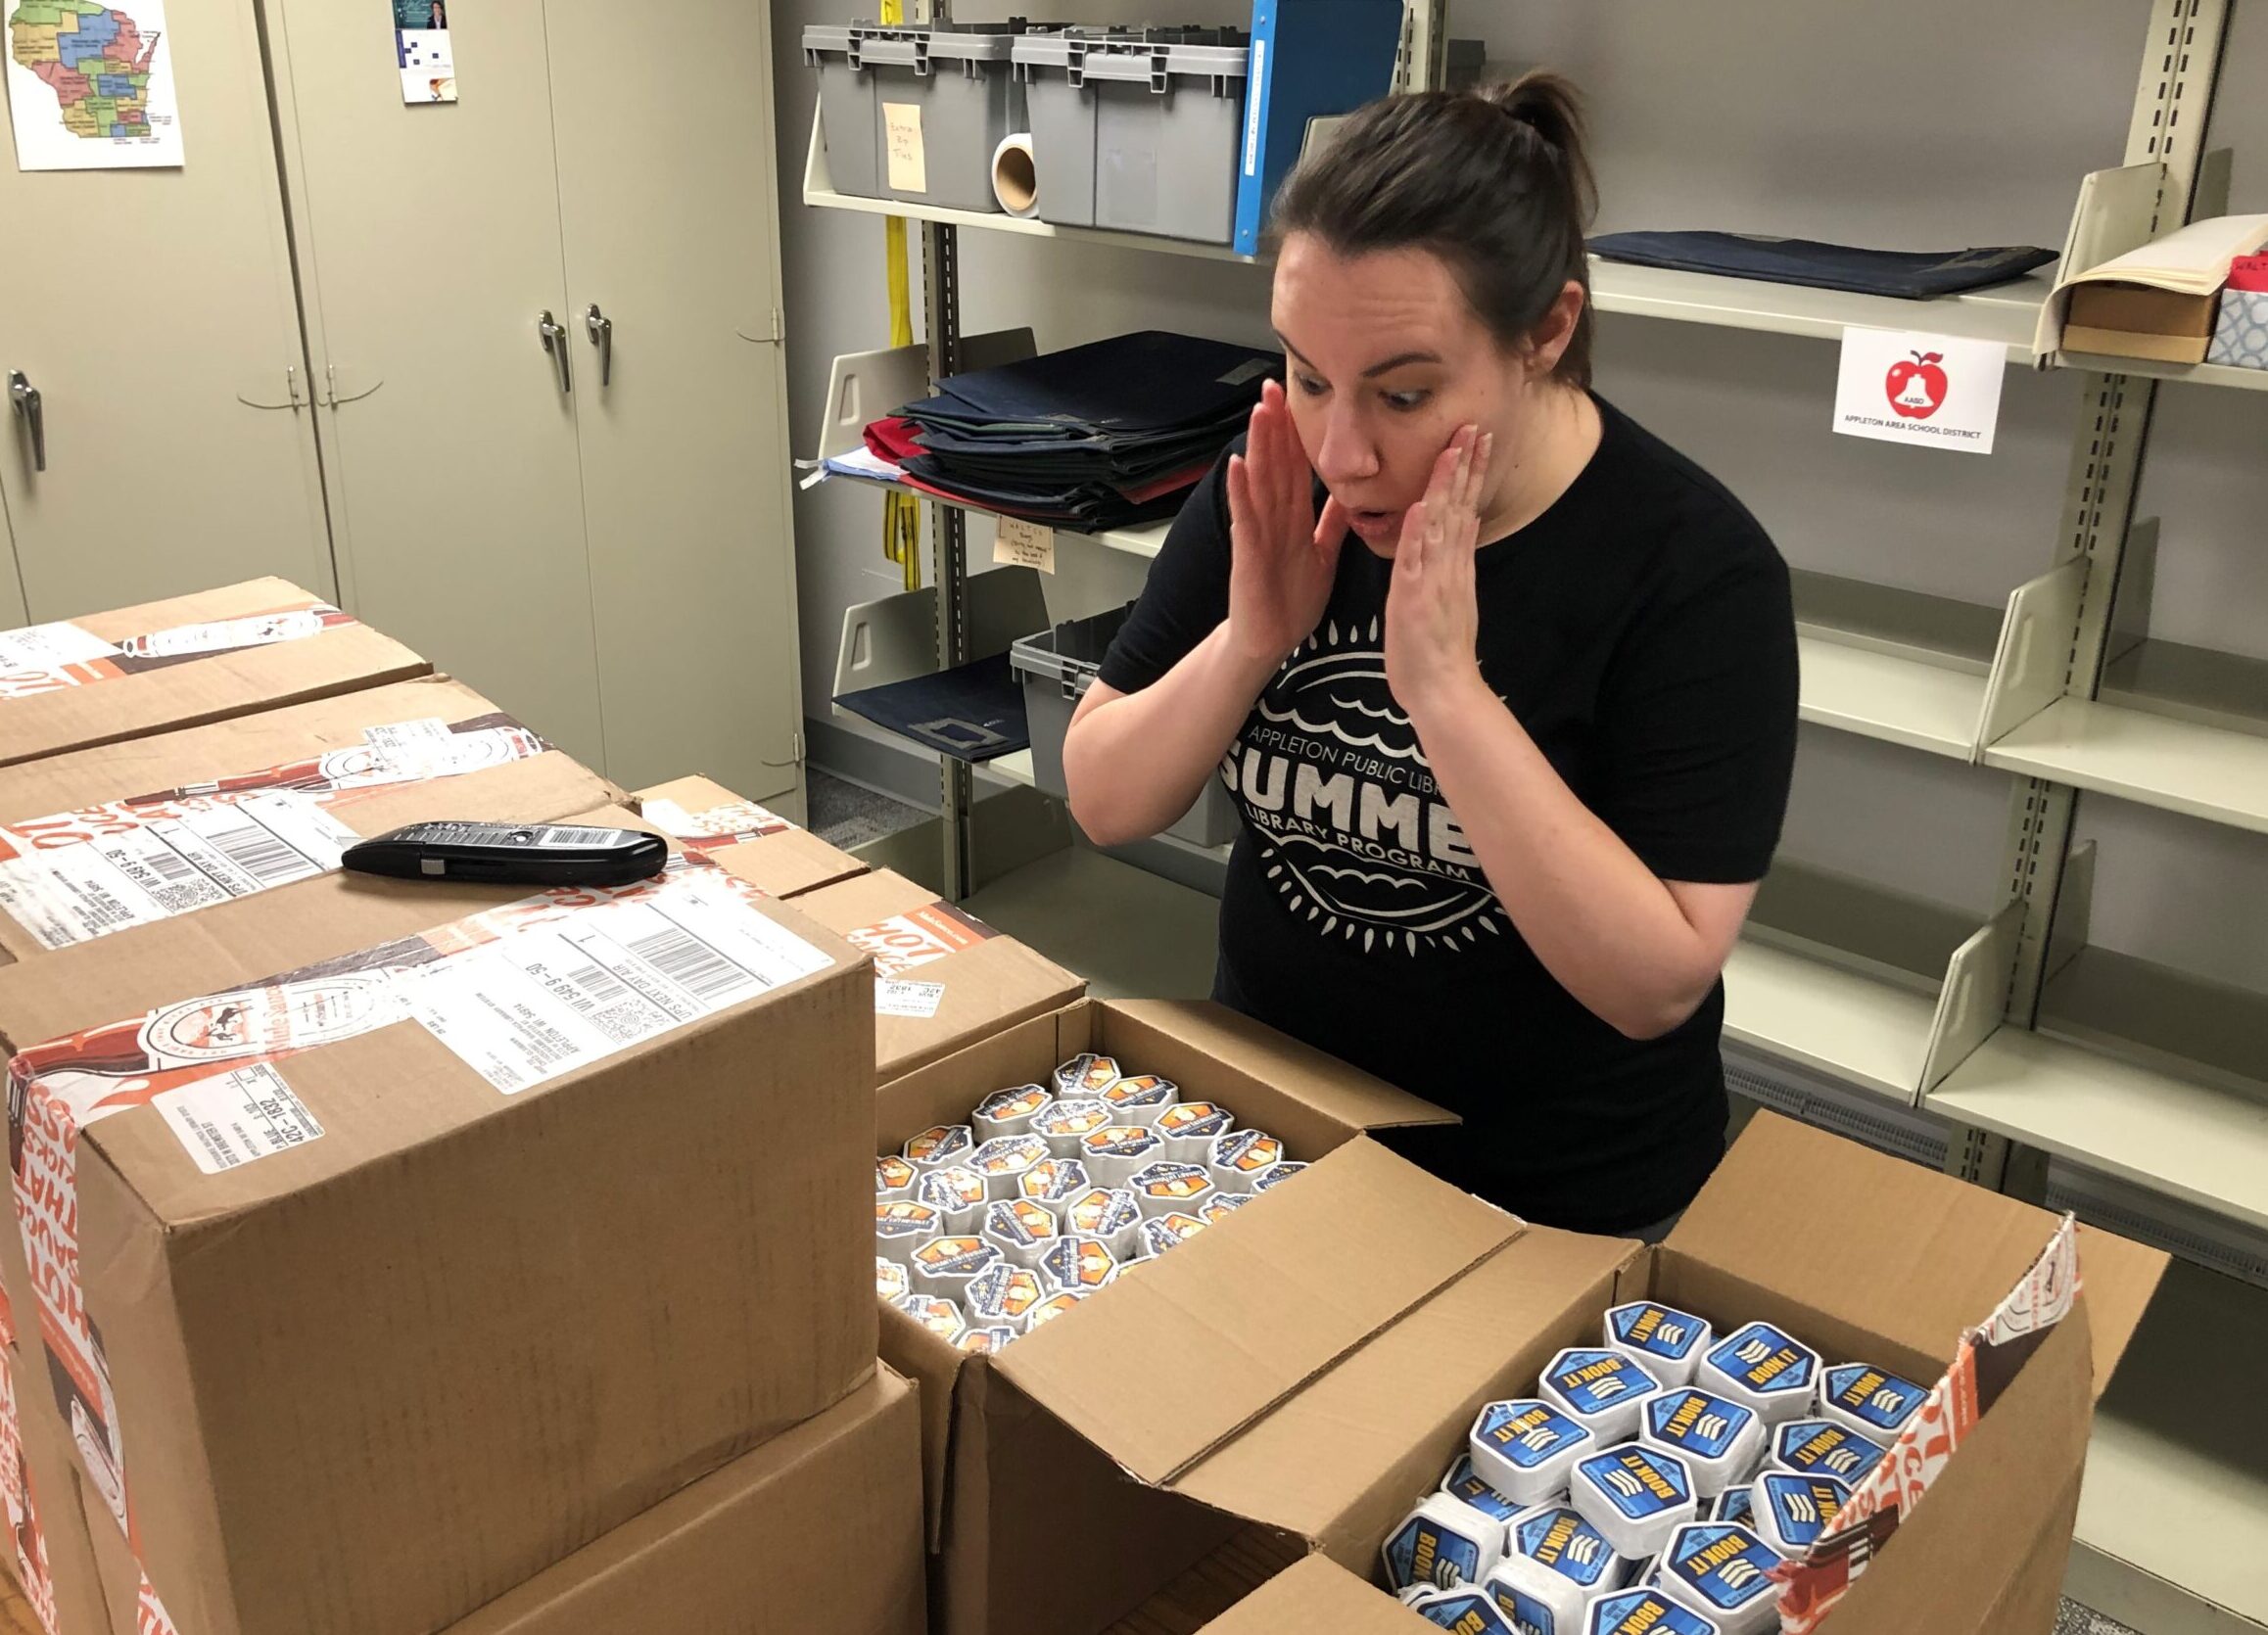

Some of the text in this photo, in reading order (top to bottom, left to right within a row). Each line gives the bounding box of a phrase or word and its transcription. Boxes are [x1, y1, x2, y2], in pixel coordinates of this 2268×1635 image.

[1844, 414, 1982, 440] APPLETON AREA SCHOOL DISTRICT
[1248, 724, 1339, 763] APPLETON
[1341, 751, 1406, 784] PUBLIC
[1245, 803, 1470, 880] LIBRARY PROGRAM
[186, 850, 204, 861] AIR
[197, 859, 218, 872] DAY
[126, 864, 150, 879] 549
[210, 869, 234, 884] NEXT
[226, 882, 248, 895] UPS
[864, 923, 951, 958] HOT
[610, 963, 633, 976] AIR
[627, 974, 652, 989] DAY
[551, 983, 581, 1000] 549
[644, 987, 673, 1005] NEXT
[569, 997, 596, 1012] WI
[667, 1003, 693, 1019] UPS
[544, 1027, 580, 1053] APPLETON
[1630, 1309, 1665, 1343] BOOK IT
[1580, 1358, 1623, 1382] BOOK
[1747, 1348, 1799, 1384] BOOK IT
[1562, 1374, 1581, 1389] IT
[1842, 1372, 1886, 1407] BOOK IT
[1493, 1408, 1551, 1444] BOOK IT
[1666, 1397, 1708, 1438] BOOK IT
[1795, 1428, 1846, 1465] BOOK IT
[1621, 1455, 1639, 1470] IT
[1630, 1465, 1677, 1499] BOOK
[1811, 1485, 1832, 1500] IT
[1536, 1518, 1578, 1565] BOOK IT
[1686, 1534, 1749, 1576] BOOK IT
